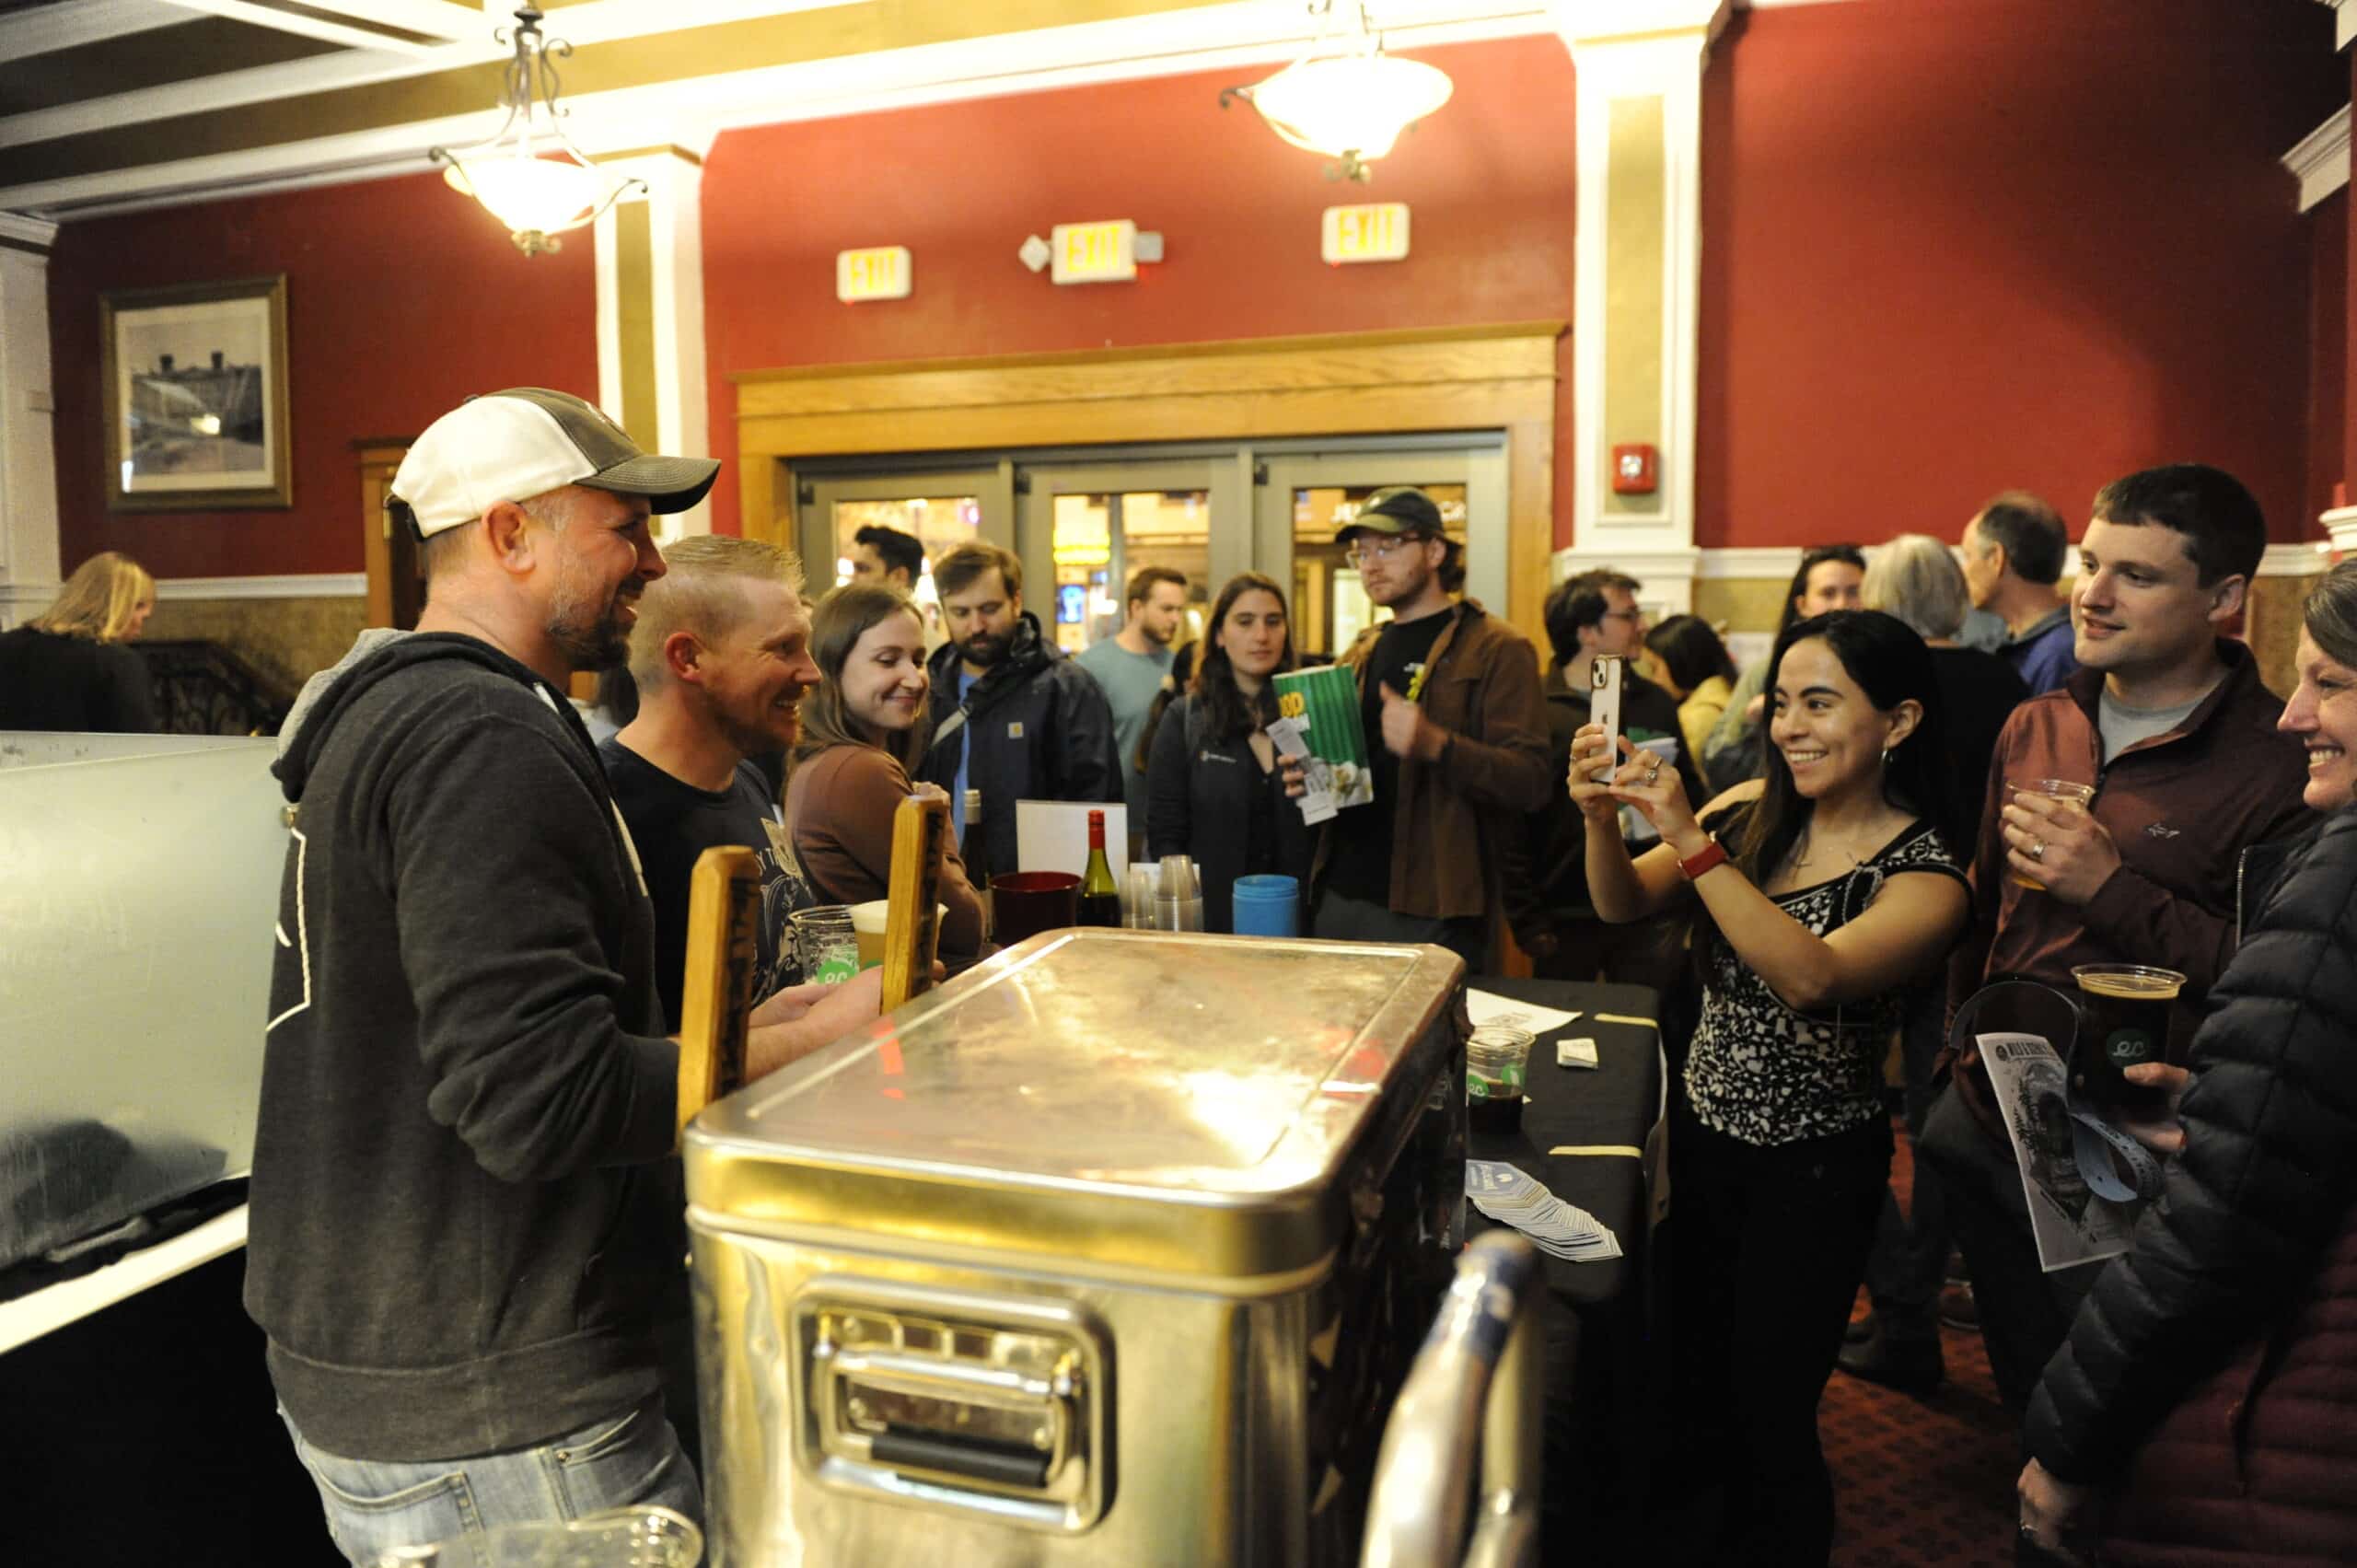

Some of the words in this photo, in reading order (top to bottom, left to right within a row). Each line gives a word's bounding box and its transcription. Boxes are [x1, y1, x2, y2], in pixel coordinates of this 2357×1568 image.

[1067, 225, 1120, 273] EXIT
[1338, 207, 1397, 252] EXIT
[849, 251, 895, 295] EXIT
